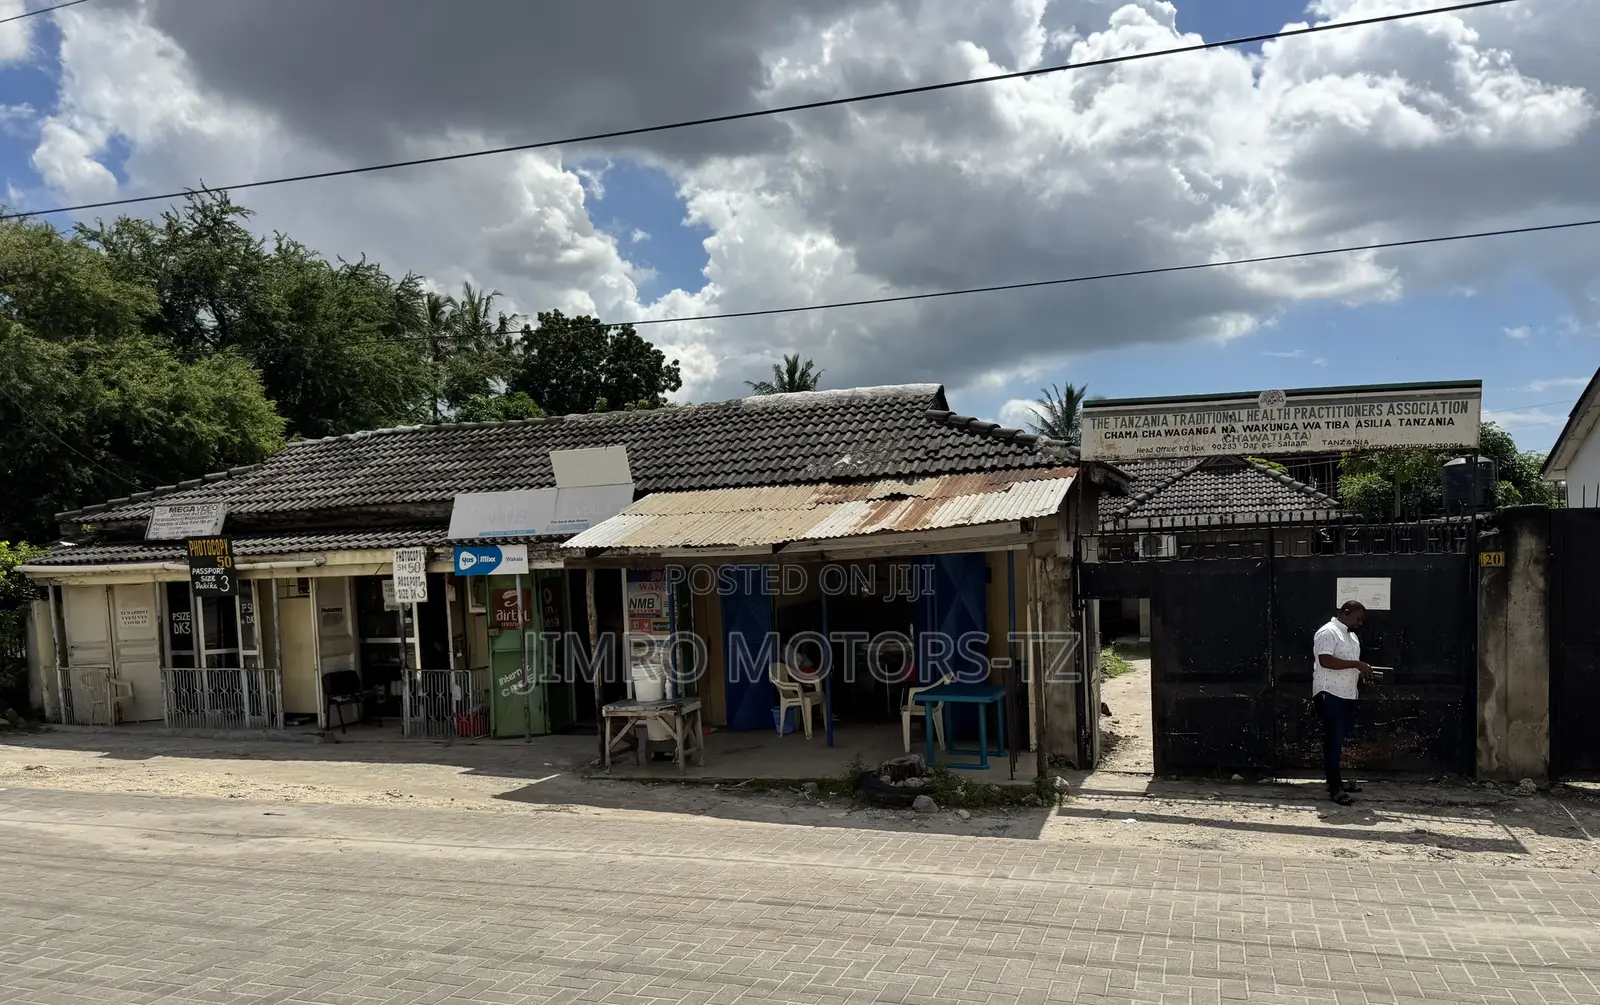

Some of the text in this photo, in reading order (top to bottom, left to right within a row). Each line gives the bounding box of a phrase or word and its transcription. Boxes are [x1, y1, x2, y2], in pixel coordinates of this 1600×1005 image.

[1091, 401, 1469, 430] THE TANZANIA TRADITIONAL HEALTH PRACTITIONERS ASSOCIATION
[1104, 417, 1455, 440] CHAMA CHA WAGANGA NA WAKUNGA WA TIBA ASILIA TANZANIA
[1222, 431, 1311, 444] (CHAWATIATA)
[1136, 446, 1153, 454] Head
[1191, 444, 1205, 452] Box
[1278, 440, 1308, 448] Salaam
[188, 539, 229, 556] PHOTOCOPY
[216, 555, 232, 569] 50
[461, 555, 476, 566] yas
[1485, 554, 1501, 565] 20
[191, 567, 225, 575] PASSPORT
[407, 561, 421, 574] 50
[219, 574, 230, 592] 3
[629, 598, 655, 609] NMB
[495, 608, 531, 622] airtl
[173, 622, 191, 635] DK3
[498, 664, 532, 686] Internt
